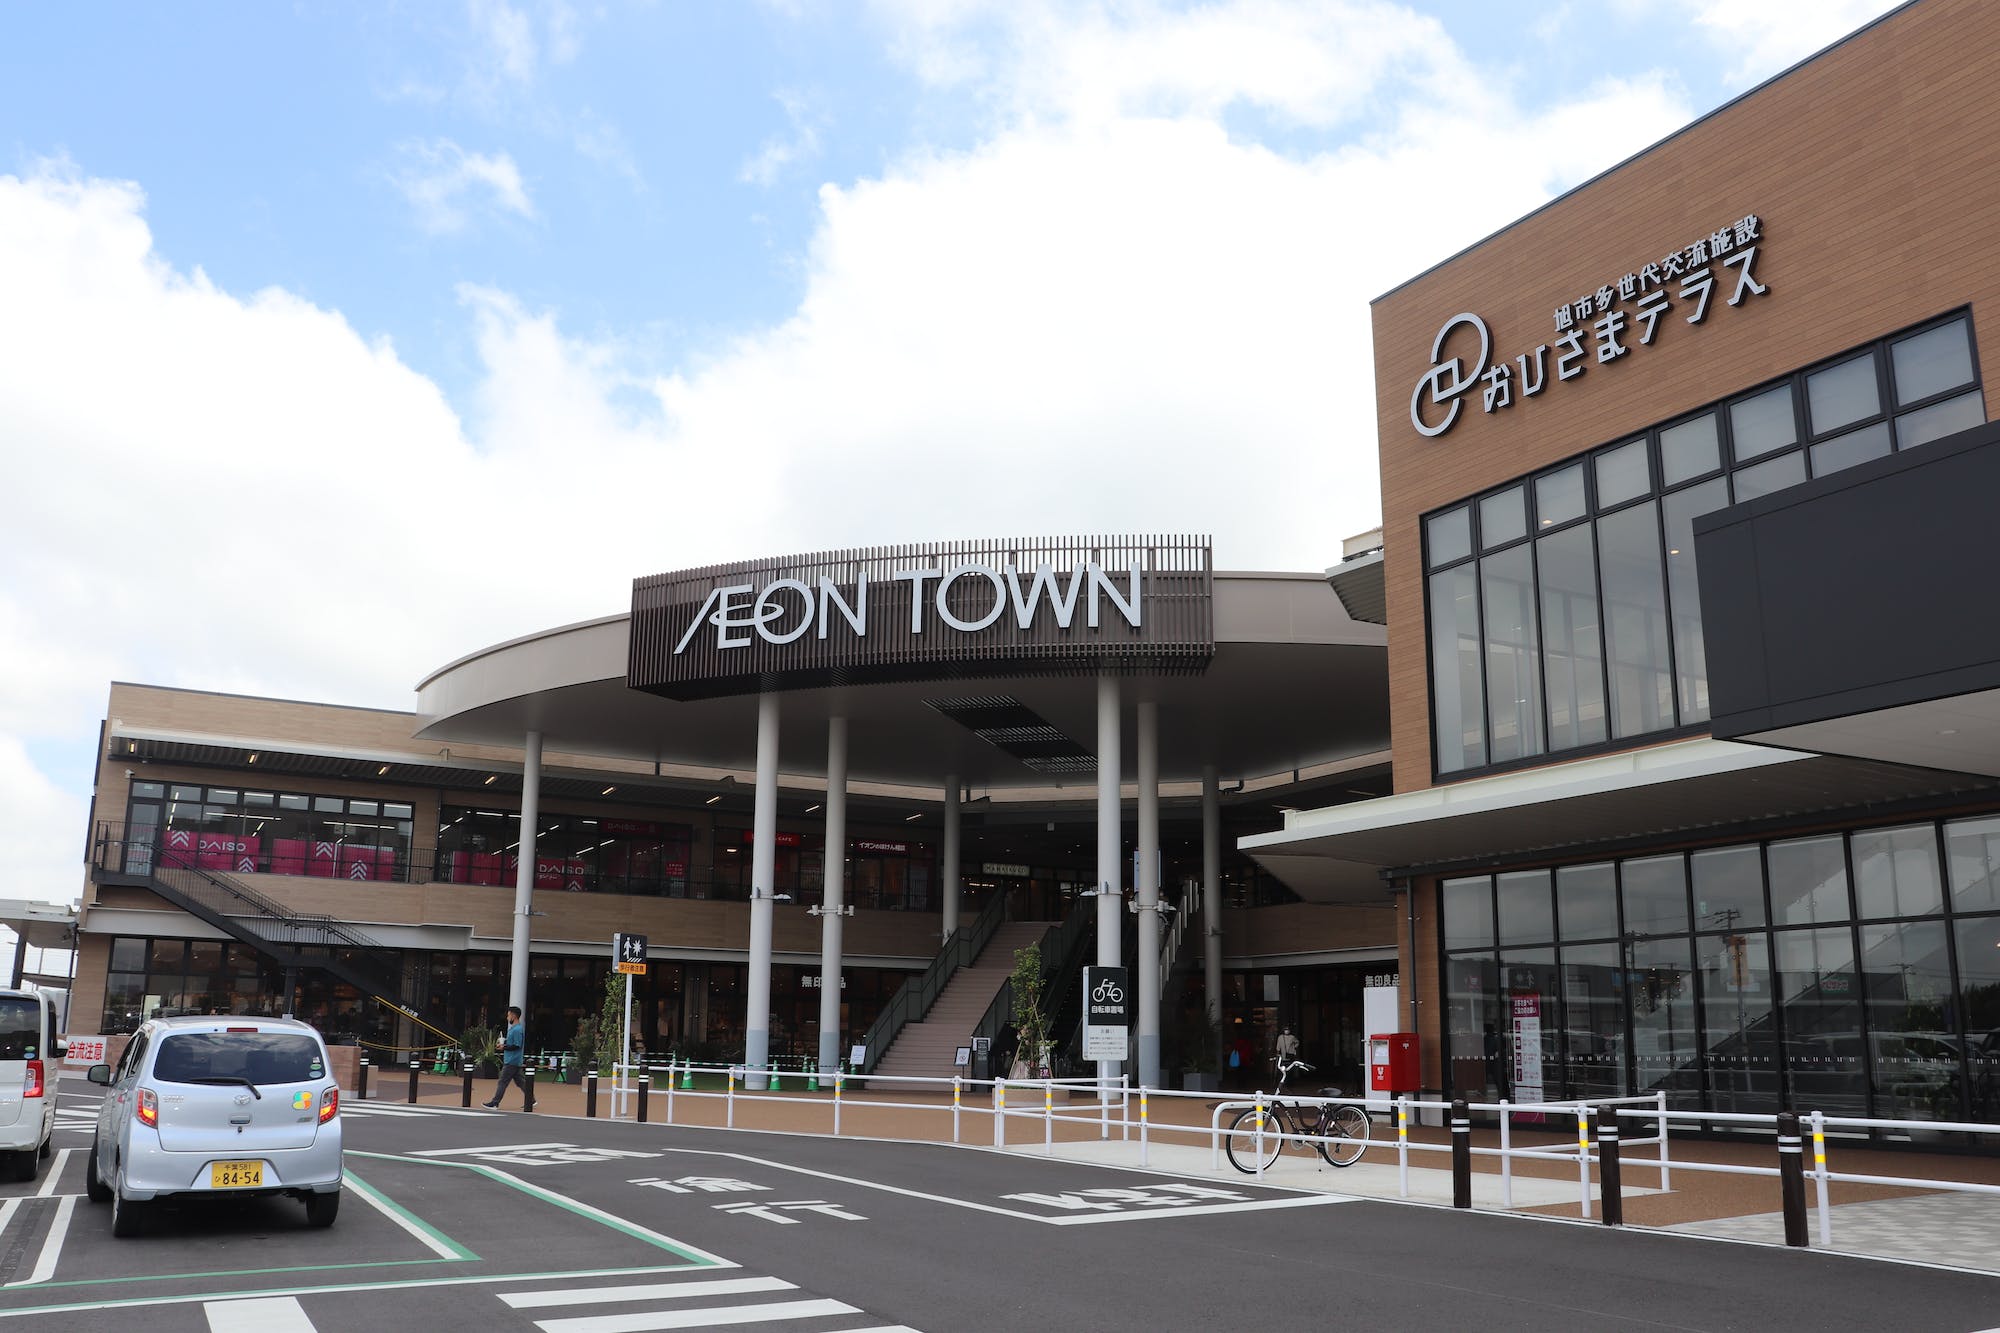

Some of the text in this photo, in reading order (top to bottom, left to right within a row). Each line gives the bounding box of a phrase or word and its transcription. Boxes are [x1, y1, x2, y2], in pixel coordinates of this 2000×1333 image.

[1553, 213, 1761, 333] 旭市多世代交流施設
[1480, 245, 1770, 414] おひさまテラス
[895, 561, 1142, 634] TOWN
[198, 839, 247, 852] DAISO
[538, 863, 585, 875] DAISO
[1365, 973, 1401, 987] 無印良品
[1091, 1005, 1125, 1015] 自転車置場
[66, 1040, 104, 1062] 合流注意
[224, 1163, 251, 1171] 千葉 581
[223, 1171, 259, 1185] 84-54
